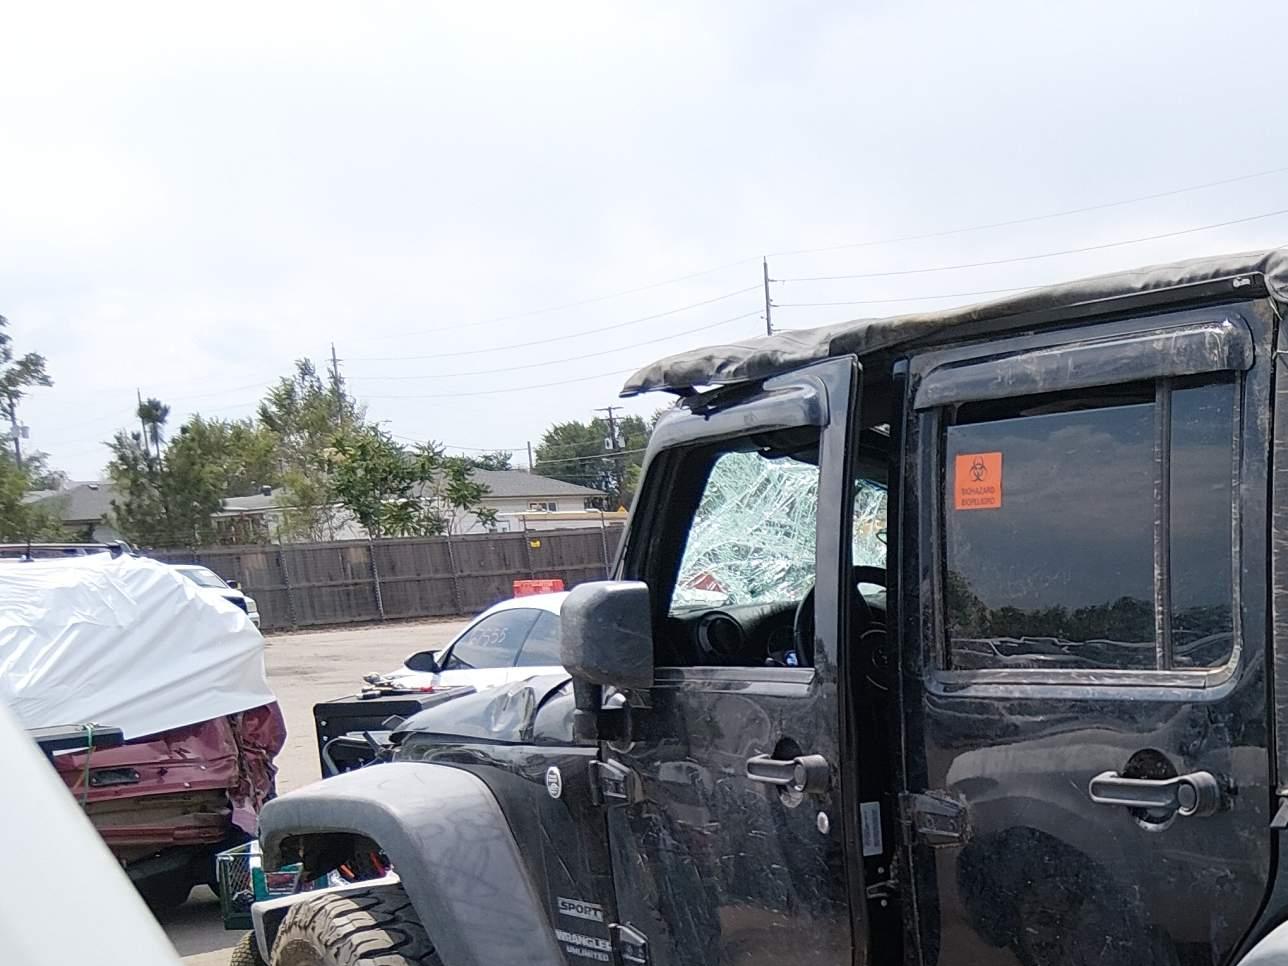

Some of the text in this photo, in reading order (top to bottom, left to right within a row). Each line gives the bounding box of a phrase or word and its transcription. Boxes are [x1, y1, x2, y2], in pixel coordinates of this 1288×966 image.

[961, 486, 996, 497] BIOHAZARD
[560, 901, 603, 919] SPORT
[555, 929, 613, 953] WRANGLER
